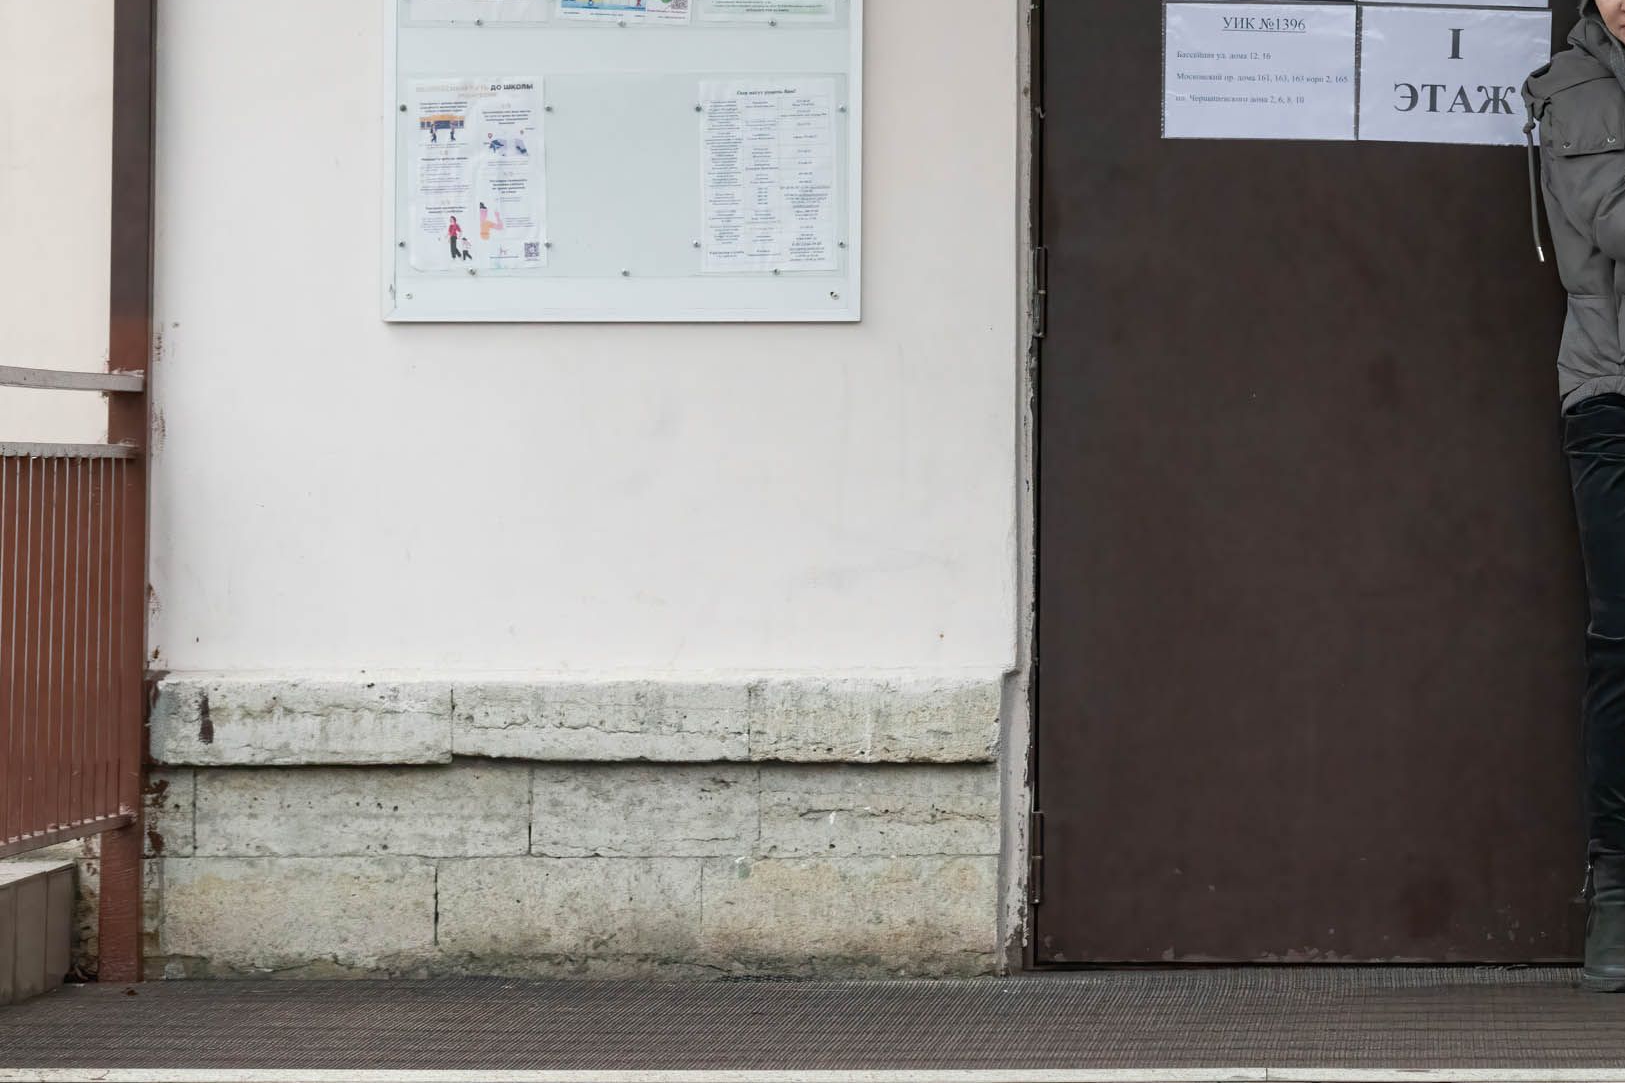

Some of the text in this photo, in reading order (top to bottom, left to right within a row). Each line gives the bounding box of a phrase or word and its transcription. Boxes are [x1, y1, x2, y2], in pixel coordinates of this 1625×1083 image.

[1222, 16, 1256, 30] УИК
[1262, 52, 1271, 60] 16
[1335, 75, 1348, 83] 165
[1296, 96, 1305, 104] 10
[1392, 82, 1516, 115] ЭТАЖ
